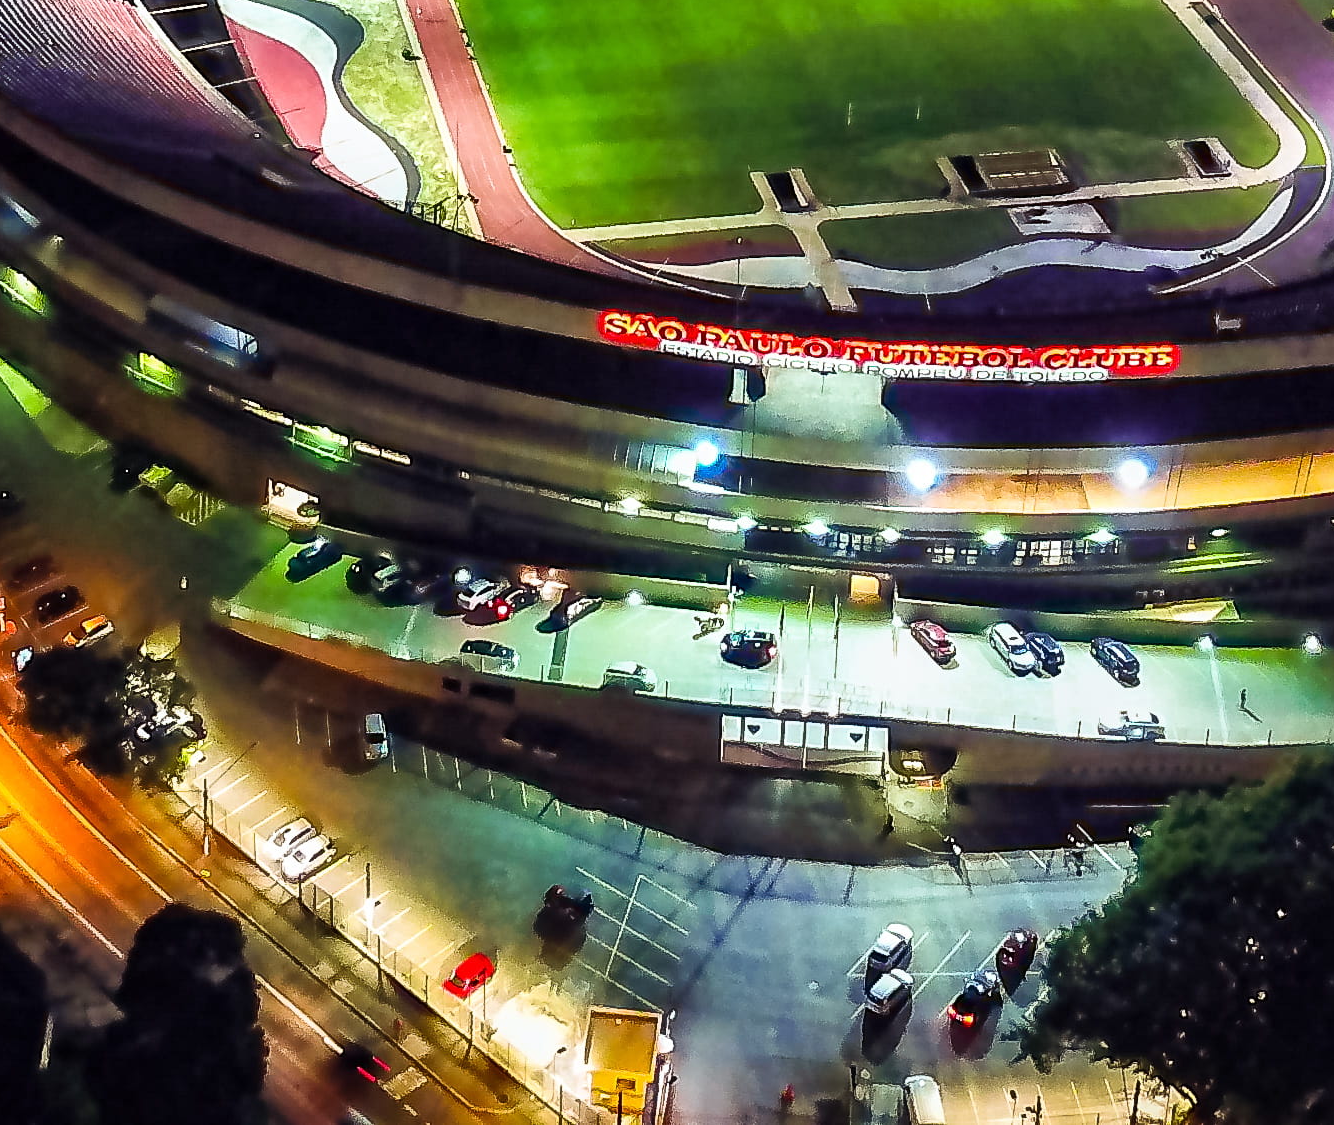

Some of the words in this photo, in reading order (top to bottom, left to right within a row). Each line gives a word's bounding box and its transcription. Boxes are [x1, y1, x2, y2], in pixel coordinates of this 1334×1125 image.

[604, 312, 686, 342] SÃO
[696, 323, 832, 358] PAULO
[844, 340, 1031, 369] FUTEBOL
[1040, 344, 1173, 370] CLUBE
[974, 368, 1008, 381] DE
